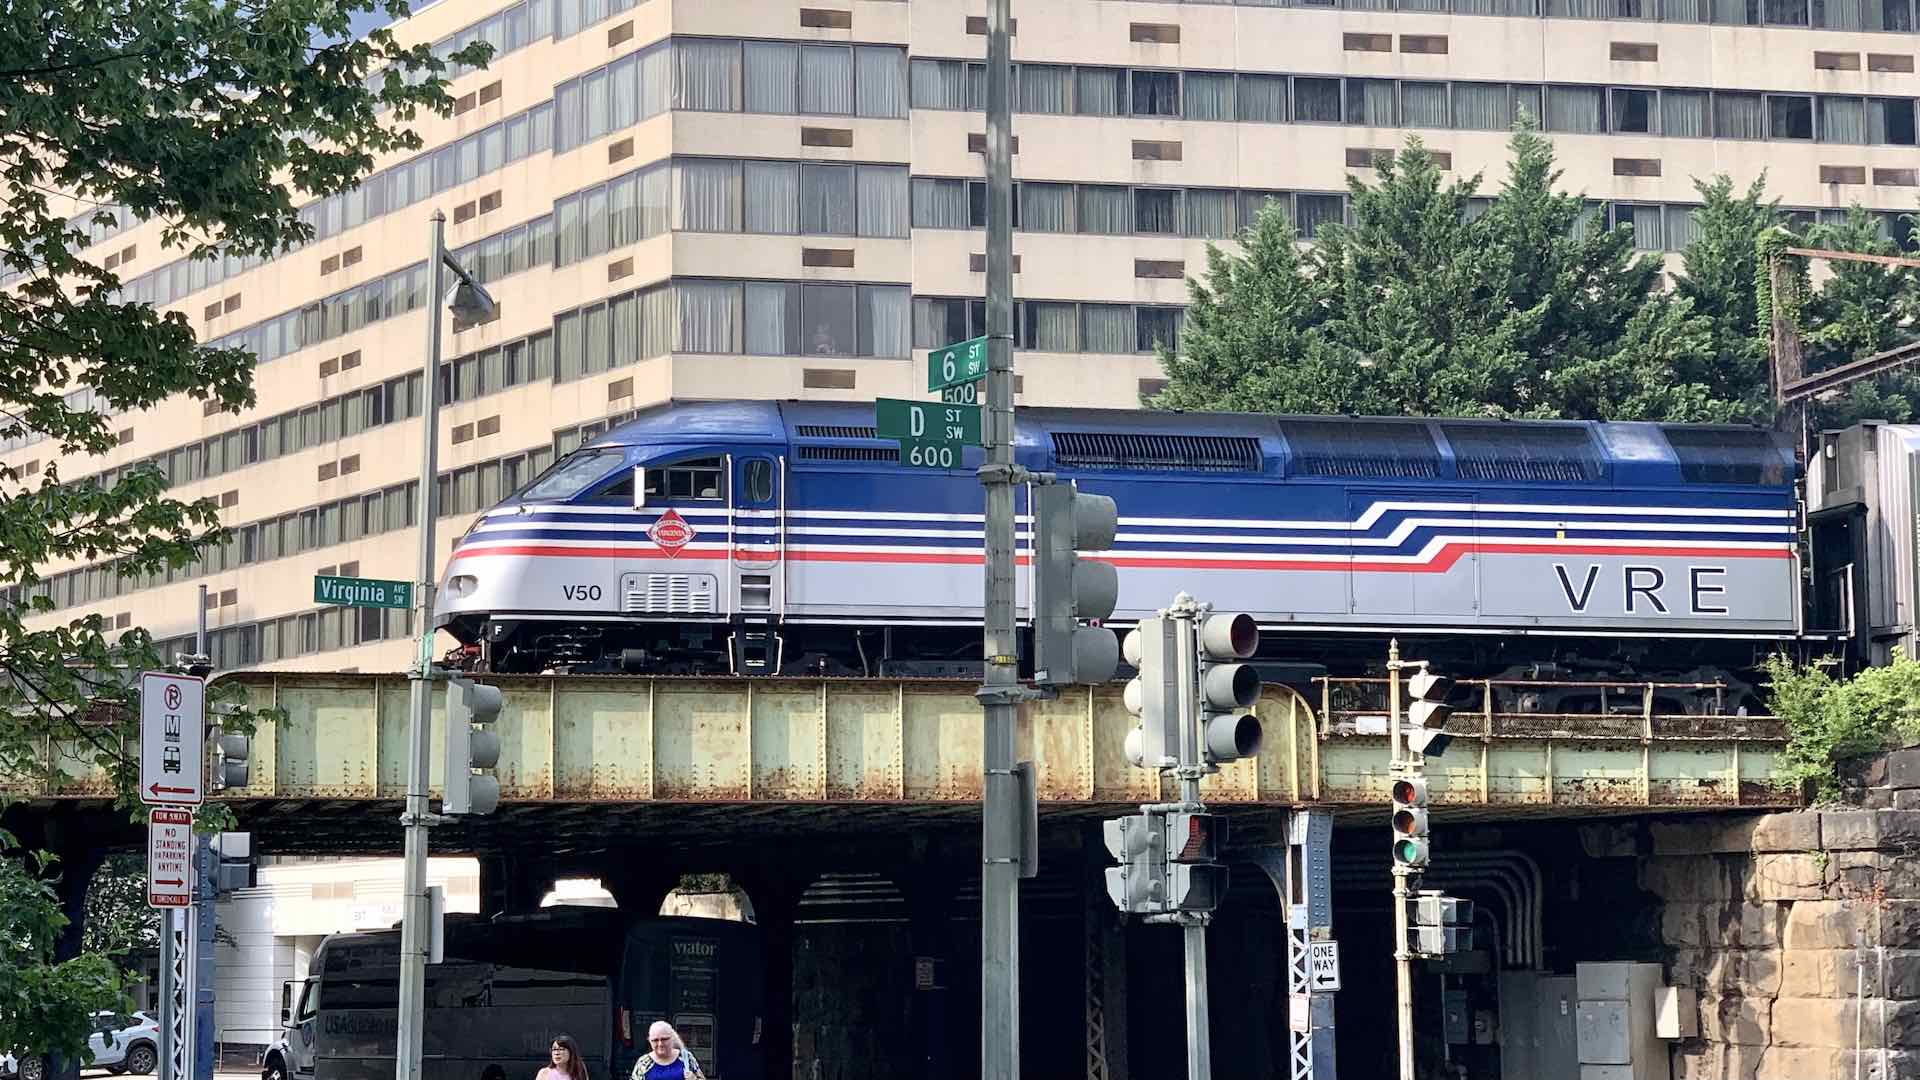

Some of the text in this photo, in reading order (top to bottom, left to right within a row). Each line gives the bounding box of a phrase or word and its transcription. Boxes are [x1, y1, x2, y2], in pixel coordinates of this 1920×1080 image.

[968, 344, 981, 359] ST
[943, 352, 956, 382] 6
[968, 361, 980, 375] SW
[944, 383, 975, 404] 500
[910, 406, 925, 437] D
[945, 409, 961, 422] ST
[945, 426, 964, 440] SW
[910, 446, 953, 467] 600
[321, 579, 385, 605] Virginia
[393, 584, 406, 594] AVE
[563, 585, 602, 601] V50
[1553, 563, 1729, 615] VRE
[393, 595, 404, 605] SW
[495, 625, 503, 635] F
[155, 811, 168, 821] TOW
[165, 827, 176, 838] NO
[155, 839, 186, 850] STANDING
[161, 851, 186, 861] PARKING
[158, 862, 182, 873] ANYTIME
[674, 940, 717, 956] viator
[1313, 946, 1334, 958] ONE
[1313, 960, 1335, 971] WAY
